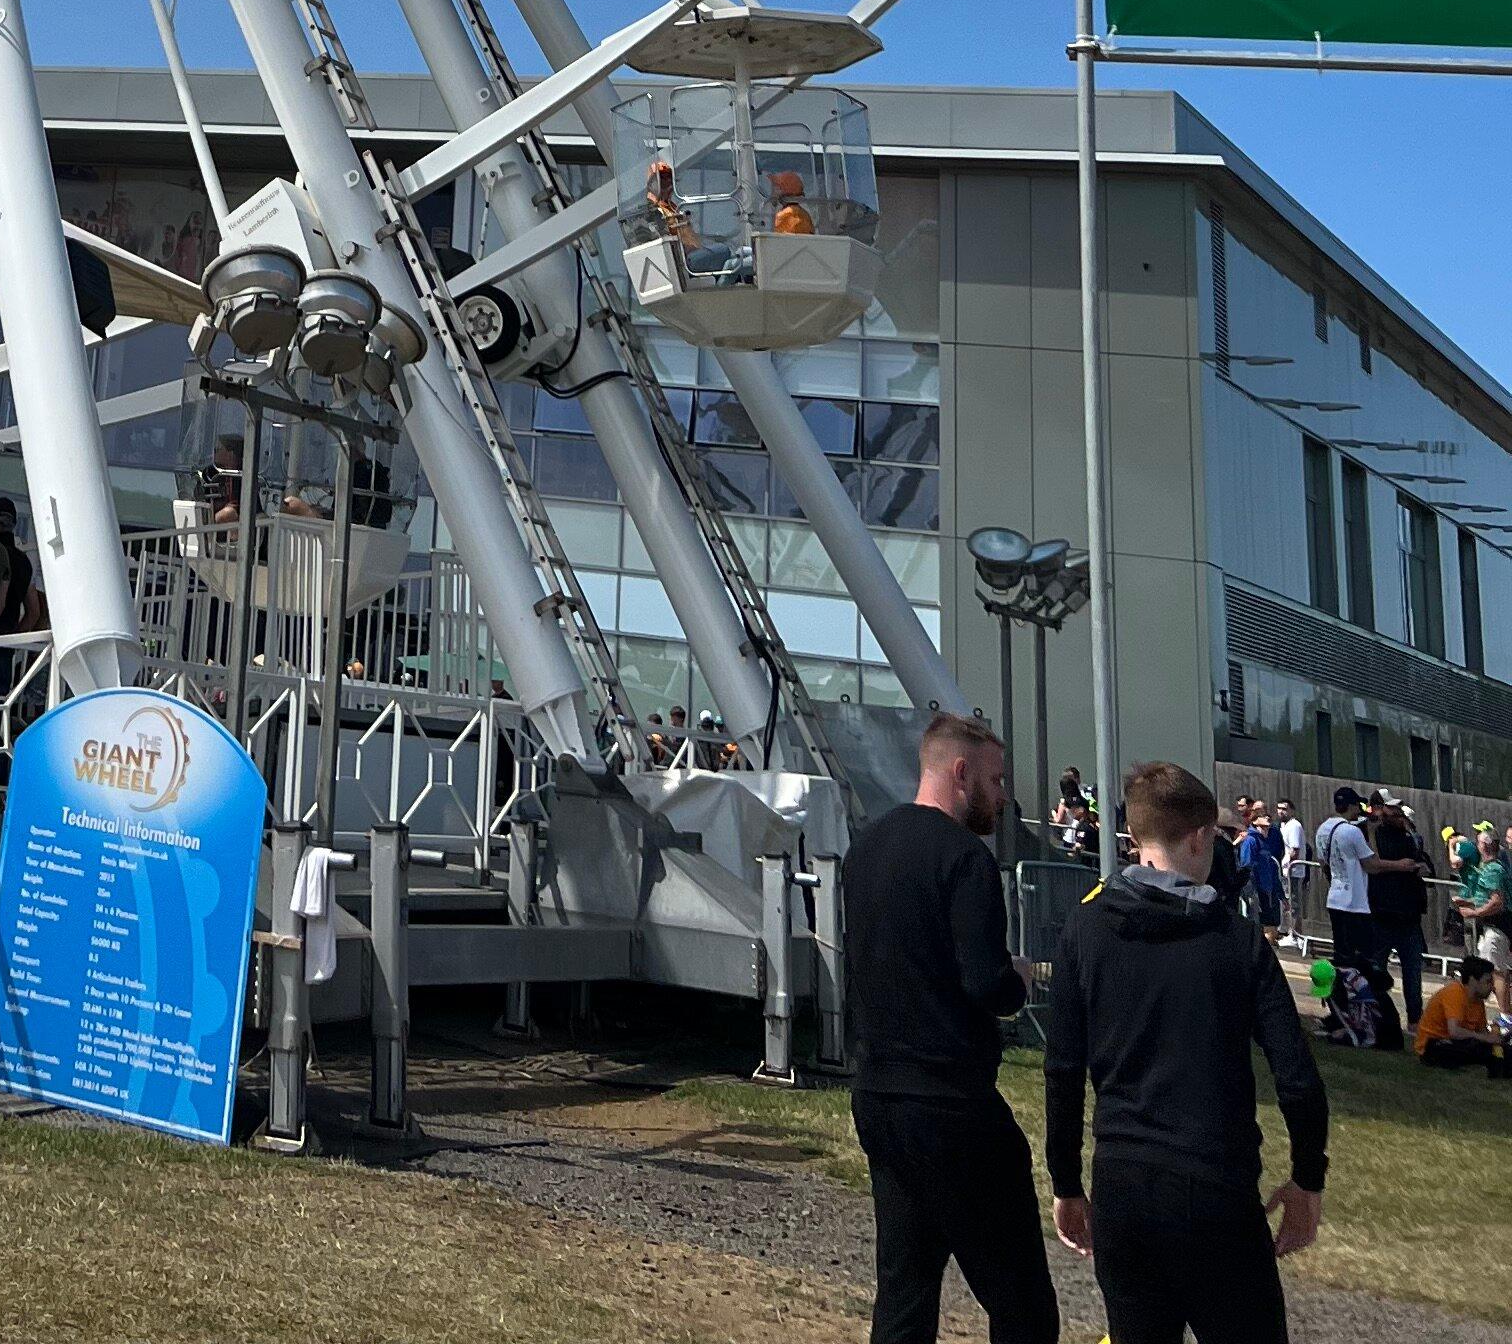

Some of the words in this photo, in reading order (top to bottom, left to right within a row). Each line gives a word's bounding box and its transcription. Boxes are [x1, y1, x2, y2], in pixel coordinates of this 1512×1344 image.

[82, 739, 162, 771] GIANT
[137, 732, 162, 749] THE
[73, 757, 158, 795] WHEEL
[61, 806, 120, 835] Technical
[123, 820, 200, 851] Information
[120, 993, 129, 1005] 10
